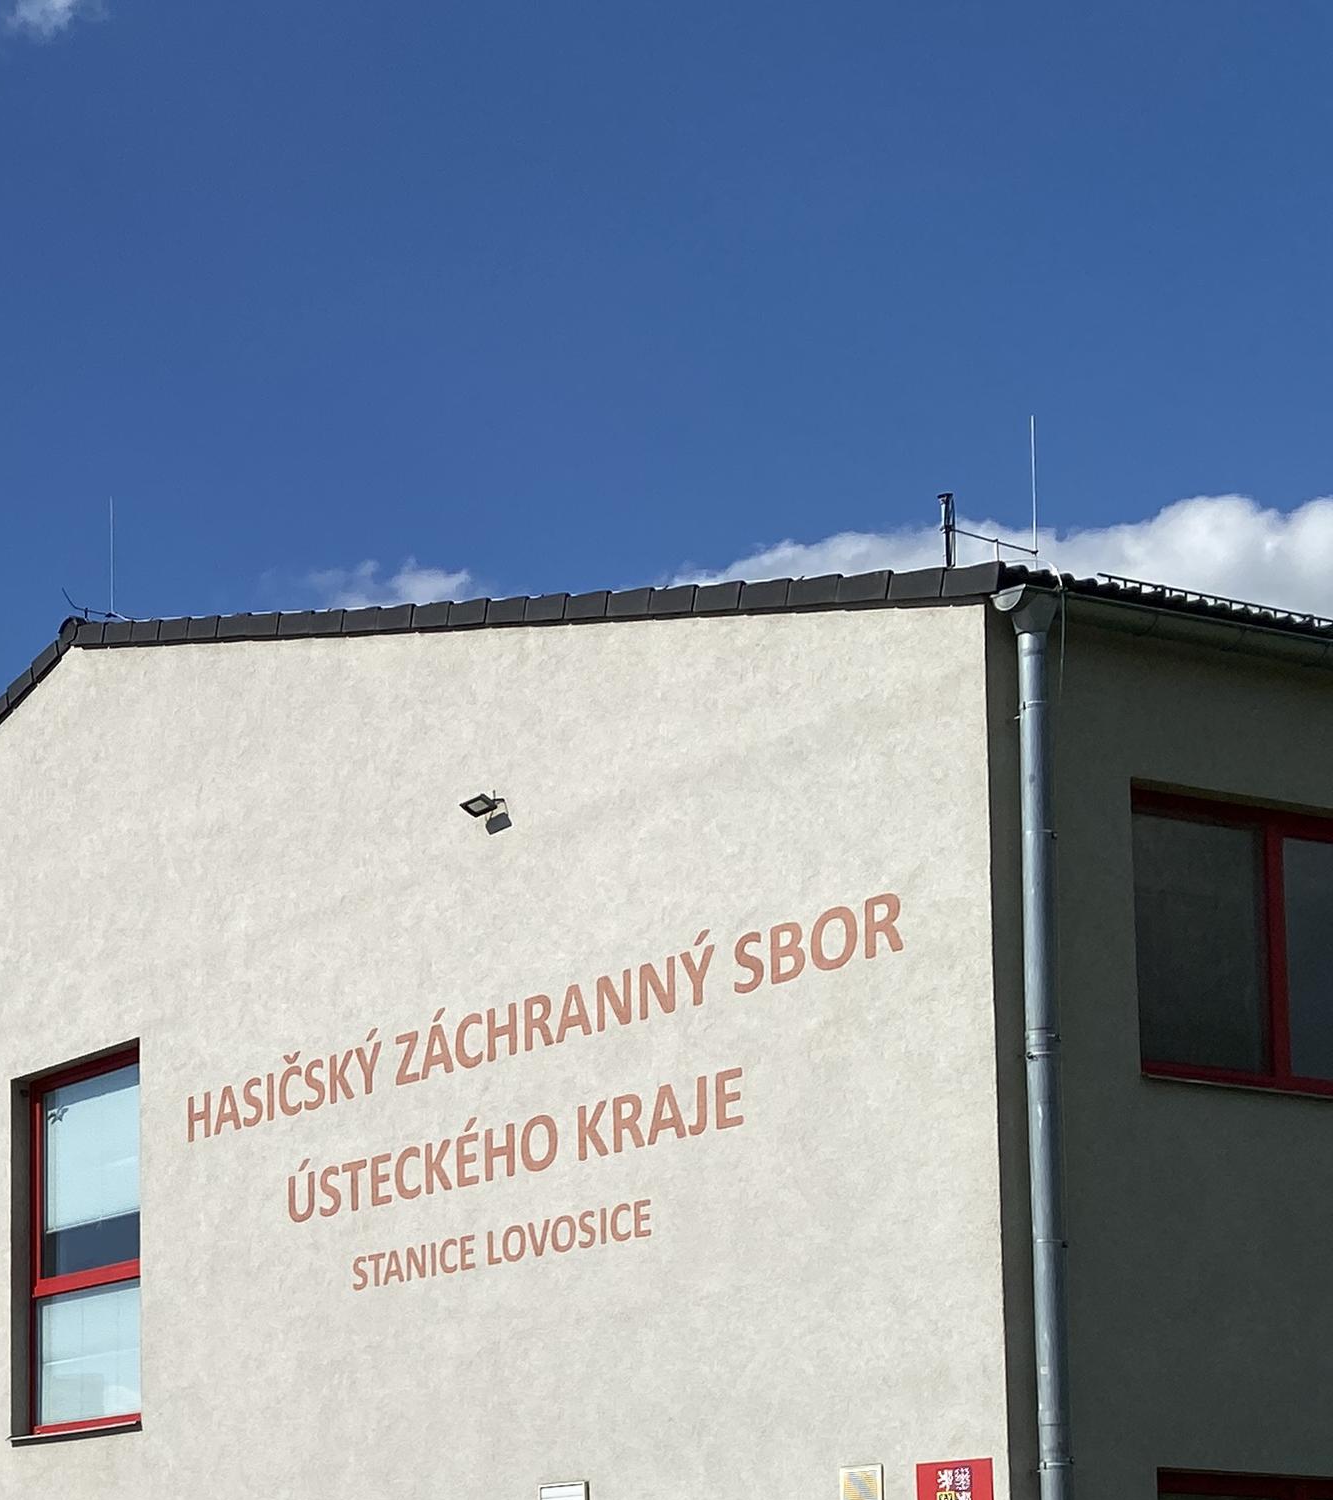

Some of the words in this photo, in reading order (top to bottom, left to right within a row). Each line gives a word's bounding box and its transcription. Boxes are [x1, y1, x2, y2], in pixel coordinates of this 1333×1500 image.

[186, 1028, 380, 1143] HASIČSKÝ
[395, 930, 716, 1086] ZÁCHRANNÝ
[733, 892, 904, 994] SBOR
[287, 1114, 559, 1223] ÚSTECKÉHO
[577, 1067, 745, 1161] KRAJE
[351, 1234, 477, 1291] STANICE
[486, 1199, 652, 1265] LOVOSICE
